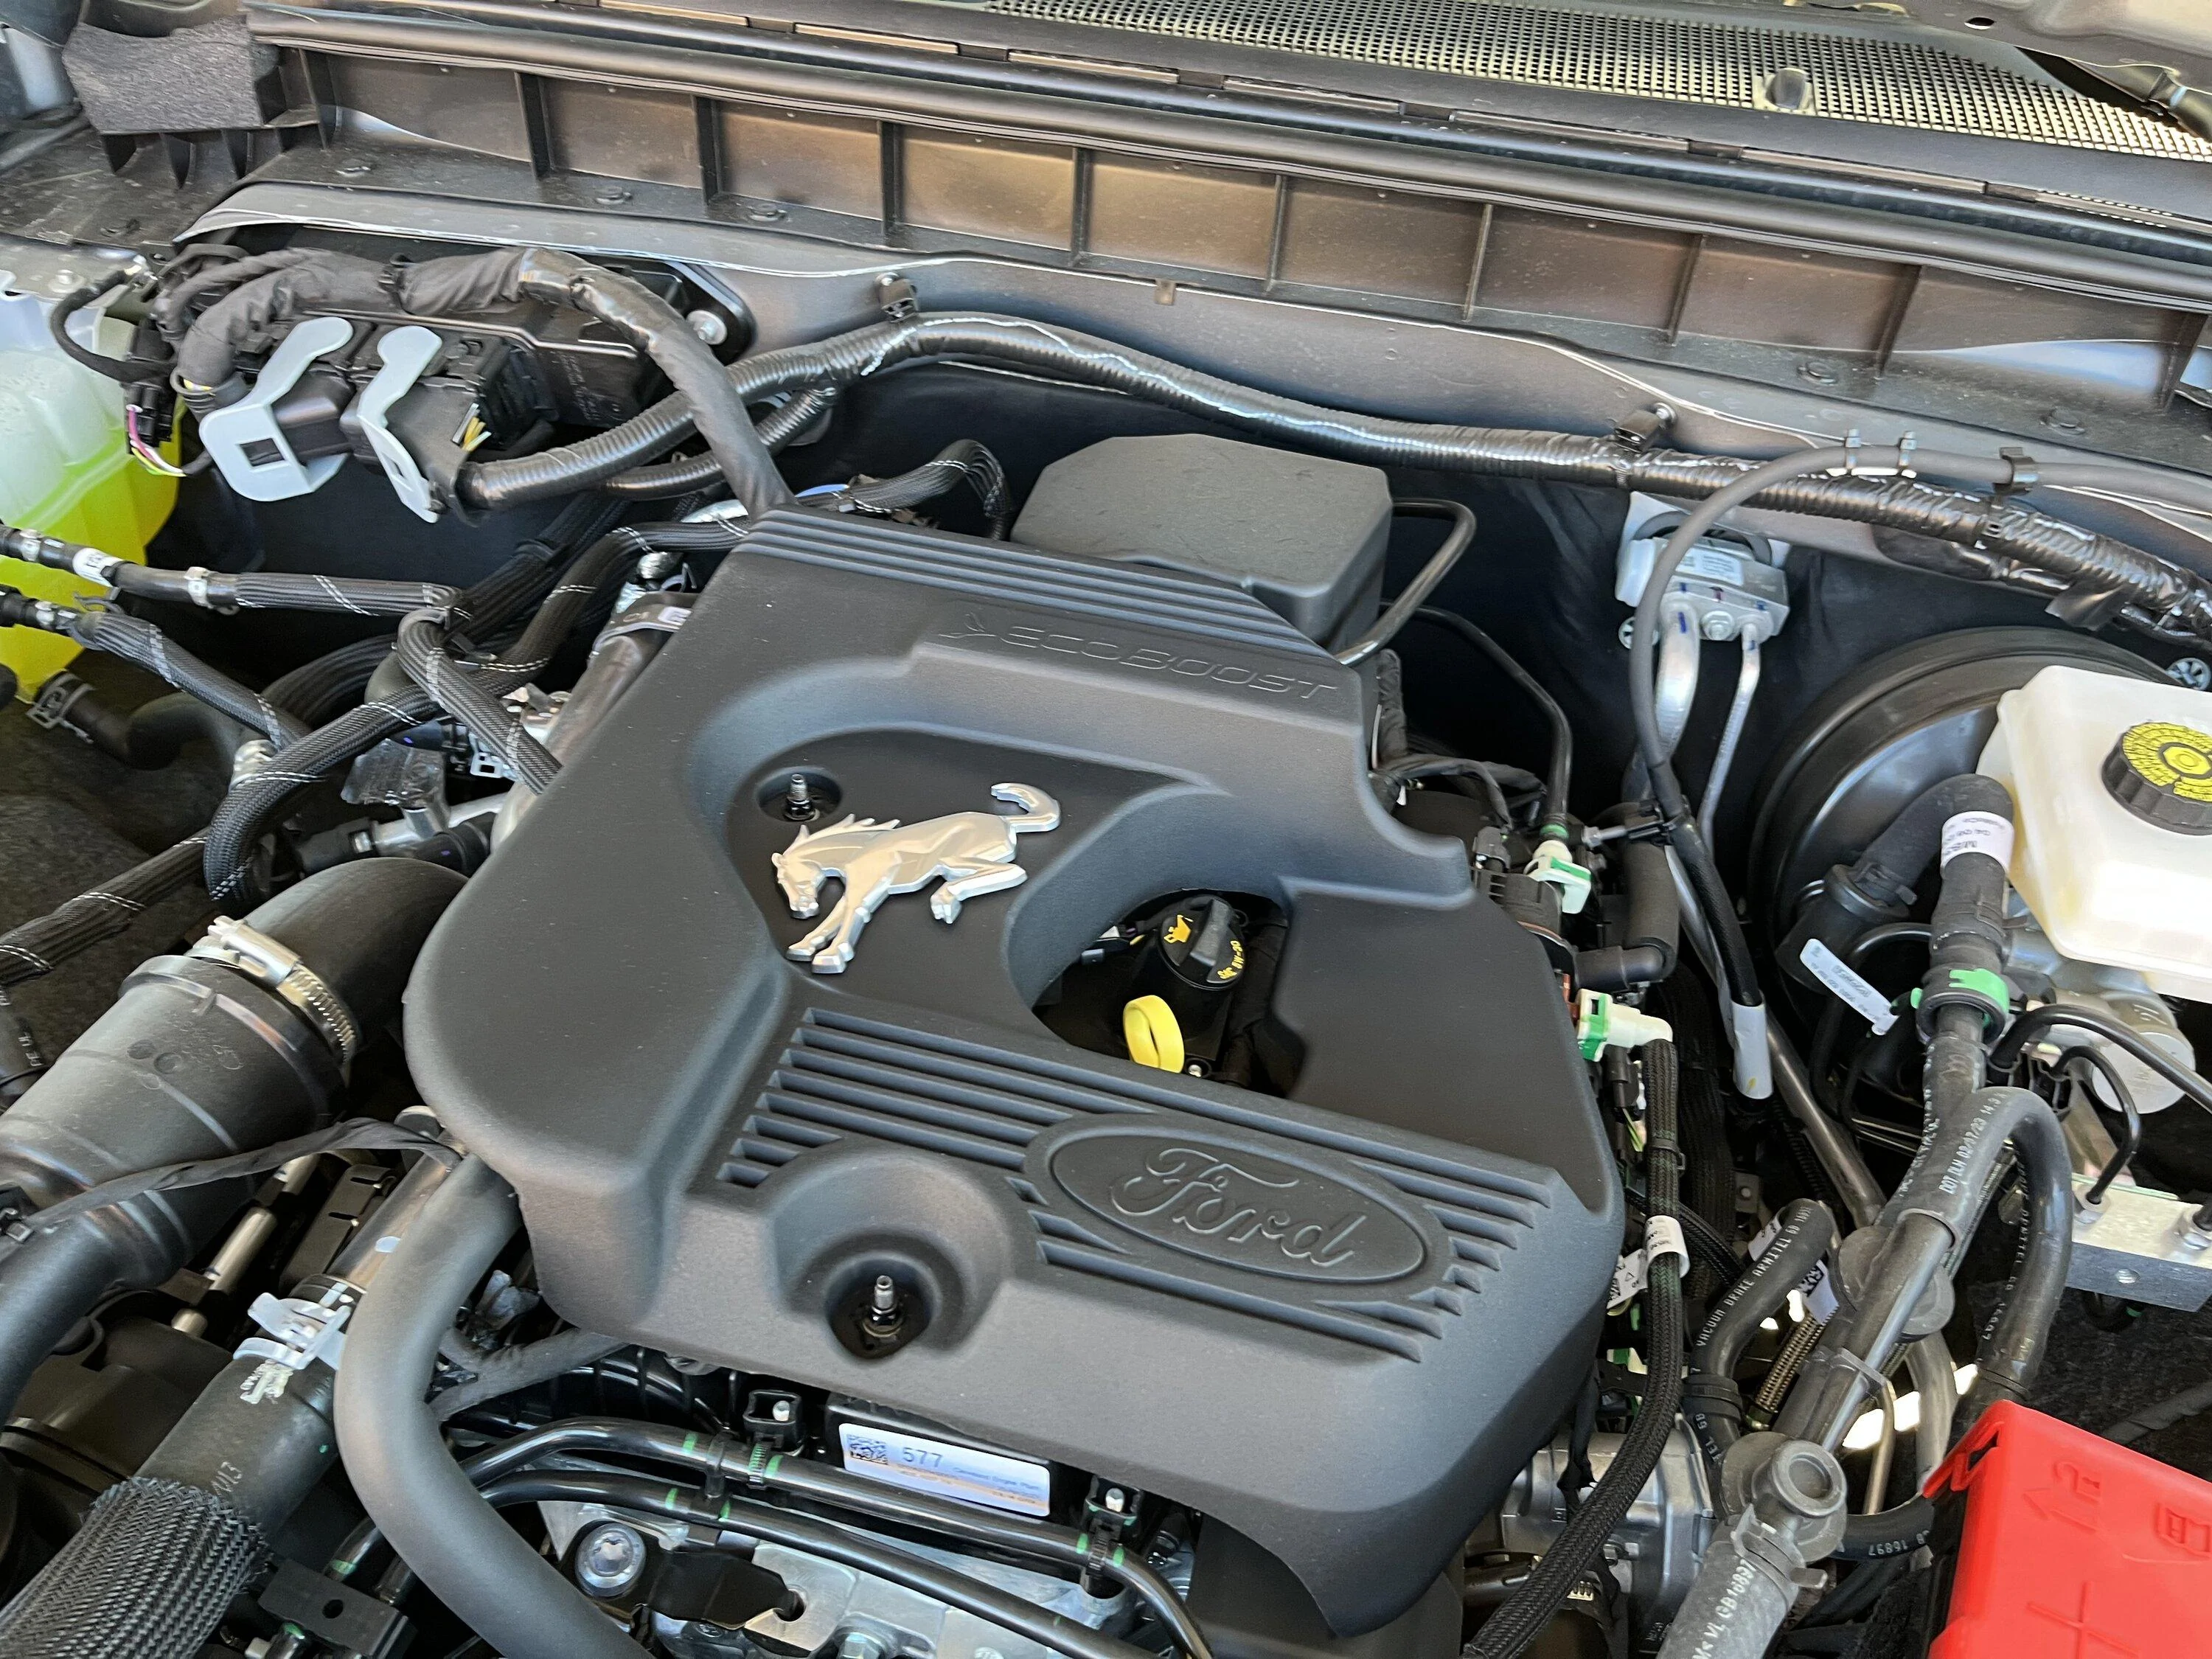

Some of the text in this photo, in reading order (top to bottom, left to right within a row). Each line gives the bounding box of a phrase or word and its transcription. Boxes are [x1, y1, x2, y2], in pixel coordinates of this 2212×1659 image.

[998, 625, 1338, 699] ECOBOOST
[1110, 1147, 1368, 1267] Ford
[1697, 1309, 1725, 1347] VACUUM
[902, 1447, 943, 1468] 577
[1868, 1539, 1908, 1556] 16897
